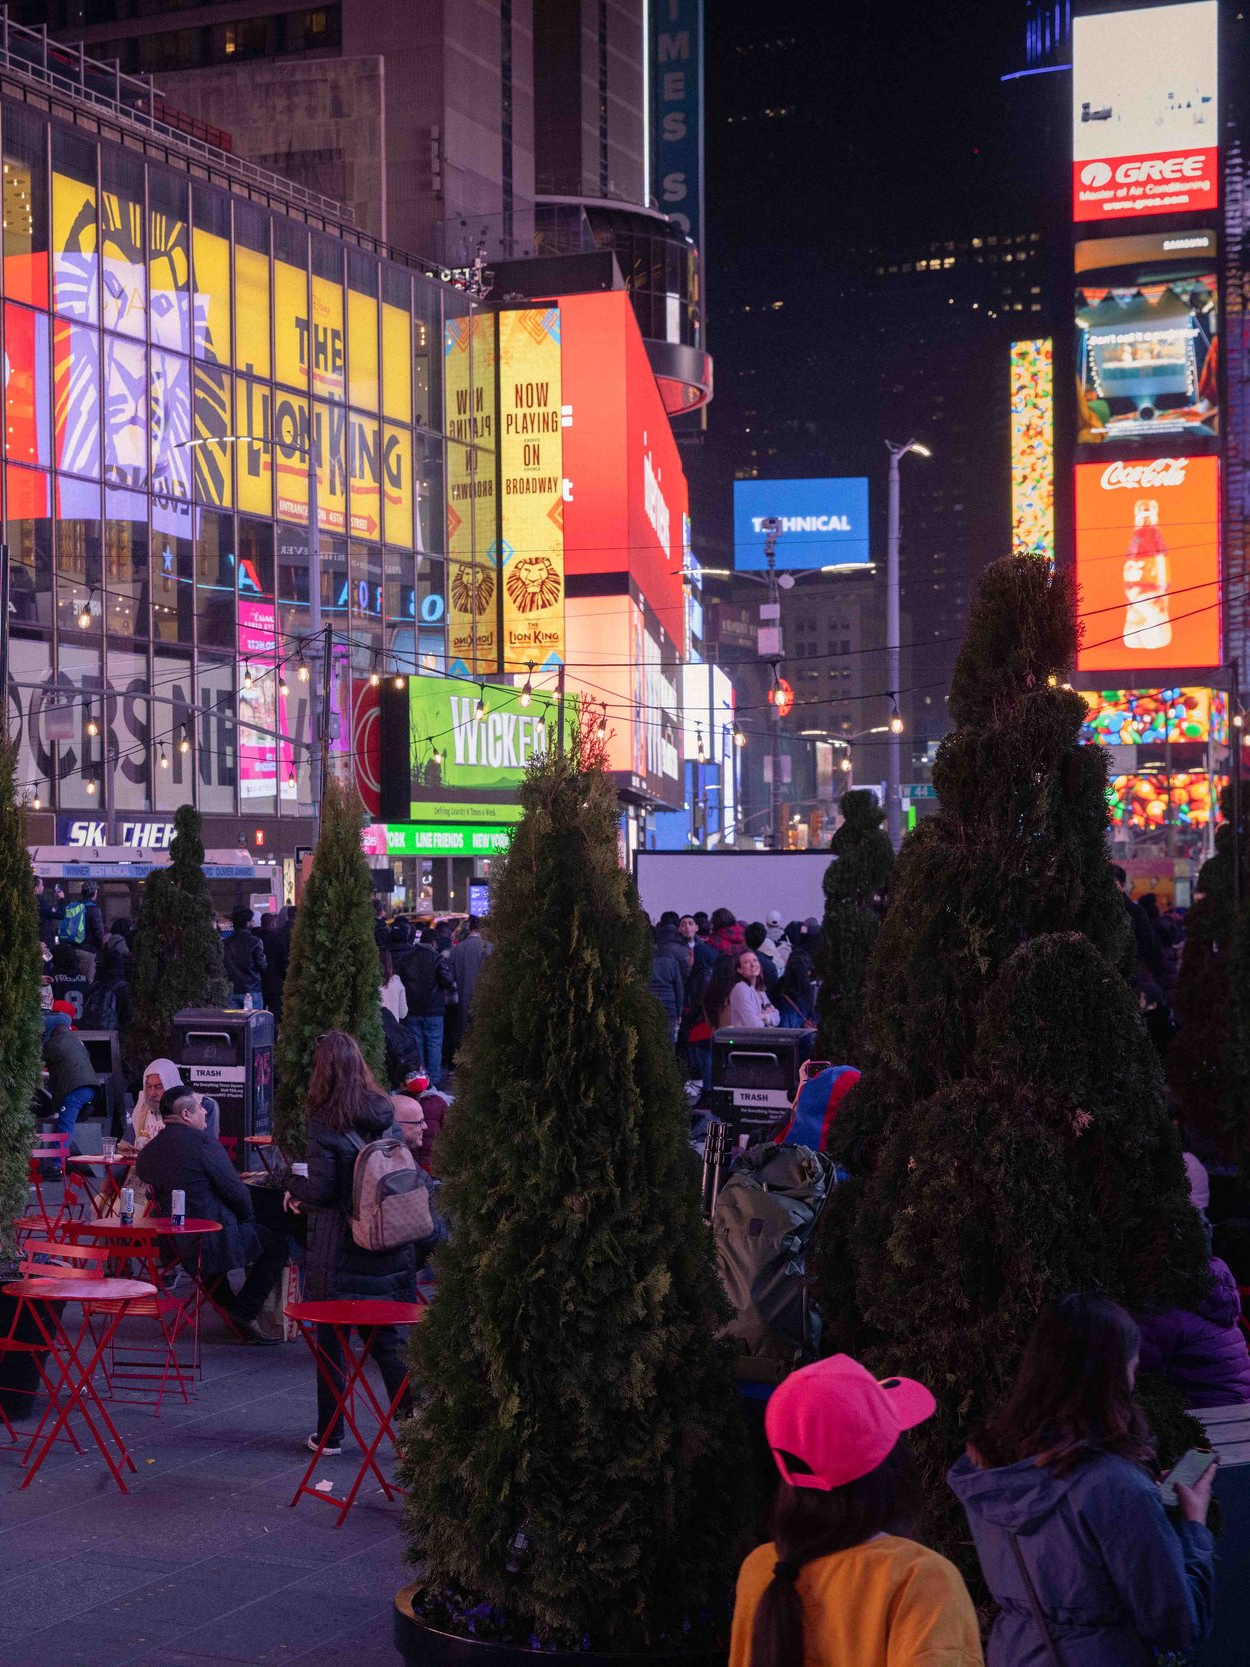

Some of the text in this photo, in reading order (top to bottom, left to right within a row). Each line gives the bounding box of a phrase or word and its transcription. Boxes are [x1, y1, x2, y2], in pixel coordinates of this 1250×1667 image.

[1115, 156, 1206, 183] GREE
[295, 316, 343, 377] THE
[515, 383, 549, 408] NOW
[245, 363, 403, 497] LION KING
[506, 412, 558, 435] PLAYING
[523, 444, 540, 466] ON
[506, 476, 558, 496] BROADWAY
[751, 515, 851, 532] THNICAL
[509, 630, 559, 645] LION KING
[387, 832, 405, 848] ORK
[416, 832, 433, 848] LINE
[433, 832, 464, 848] FRIENDS
[472, 833, 490, 848] NEW
[196, 1069, 221, 1077] TRASH
[740, 1093, 768, 1102] TRASH
